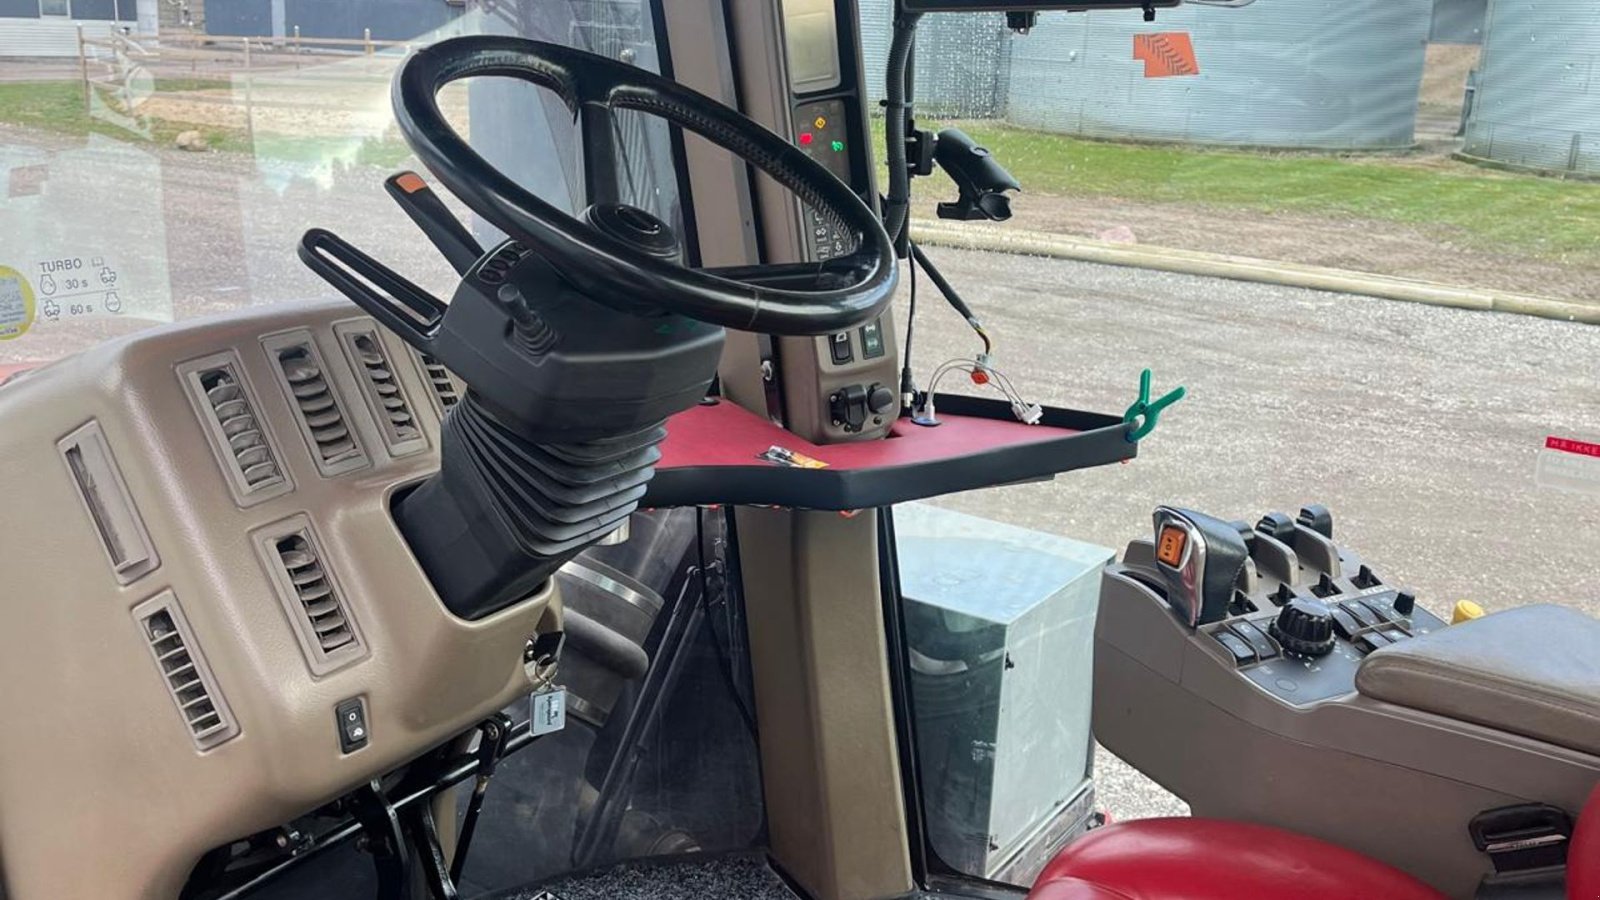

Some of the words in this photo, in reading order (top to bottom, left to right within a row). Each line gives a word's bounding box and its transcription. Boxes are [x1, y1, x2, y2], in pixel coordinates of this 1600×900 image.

[40, 258, 82, 272] TURBO
[65, 279, 78, 289] 30
[82, 279, 88, 288] s
[70, 304, 83, 315] 60
